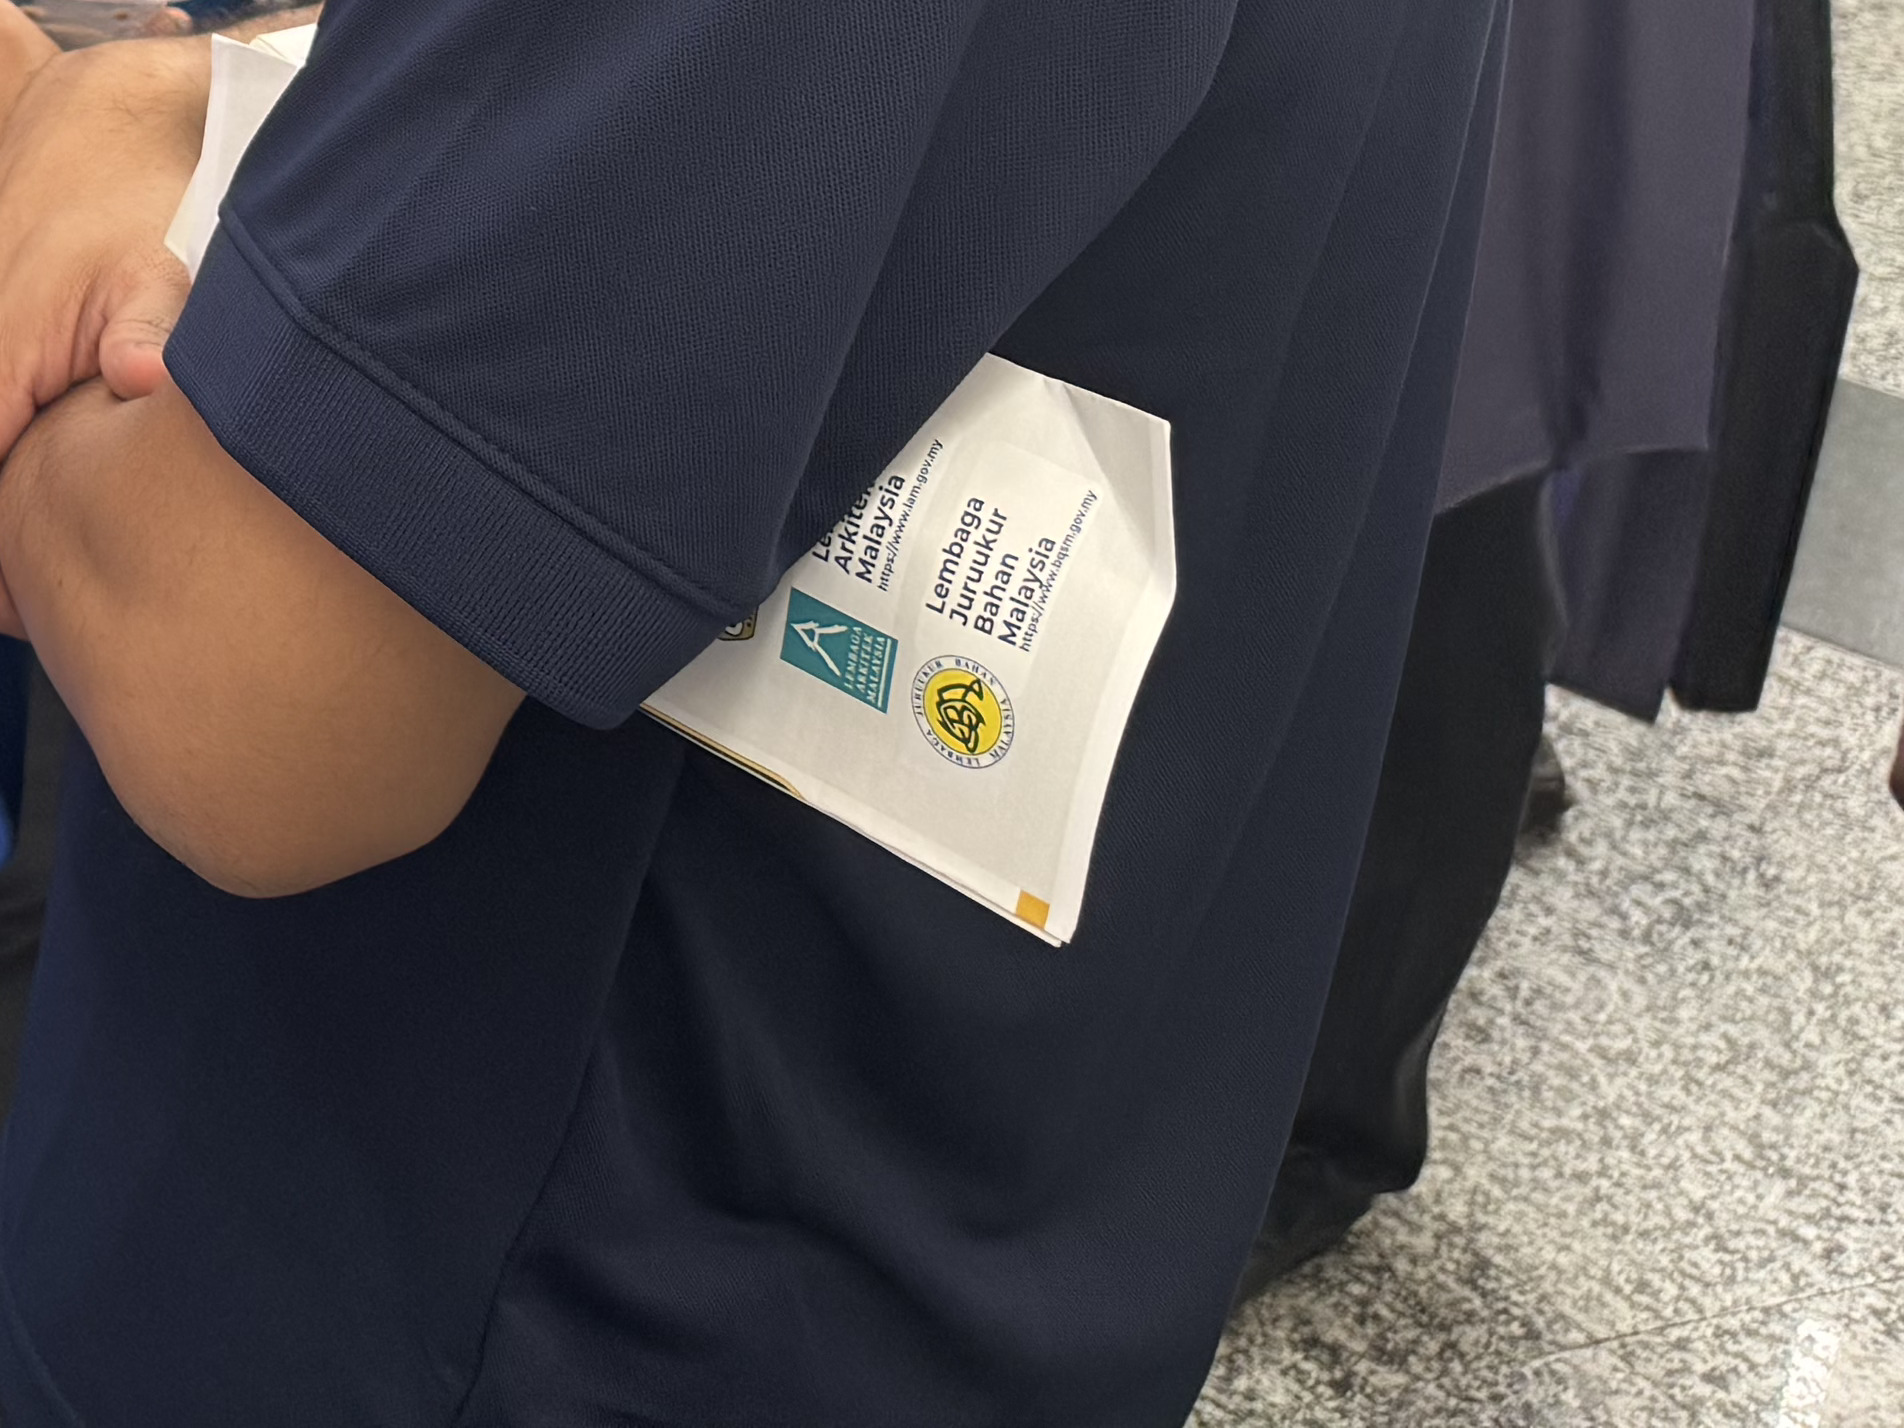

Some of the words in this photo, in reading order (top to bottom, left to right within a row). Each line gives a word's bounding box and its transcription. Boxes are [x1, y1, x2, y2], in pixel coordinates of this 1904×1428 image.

[855, 474, 906, 584] Malaysia
[877, 438, 944, 593] https://www.lam.gov.my
[925, 496, 986, 615] Lembaga
[949, 508, 1008, 626] Juruukur
[973, 552, 1020, 636] Bahan
[996, 535, 1057, 647] Malaysia
[1021, 489, 1098, 653] https://www.bqsm.gov.my
[844, 626, 863, 690] LEMBAGA
[855, 632, 875, 694] ARKITEK
[866, 636, 887, 704] MALAYSIA
[989, 697, 1015, 760] MALAYSIA
